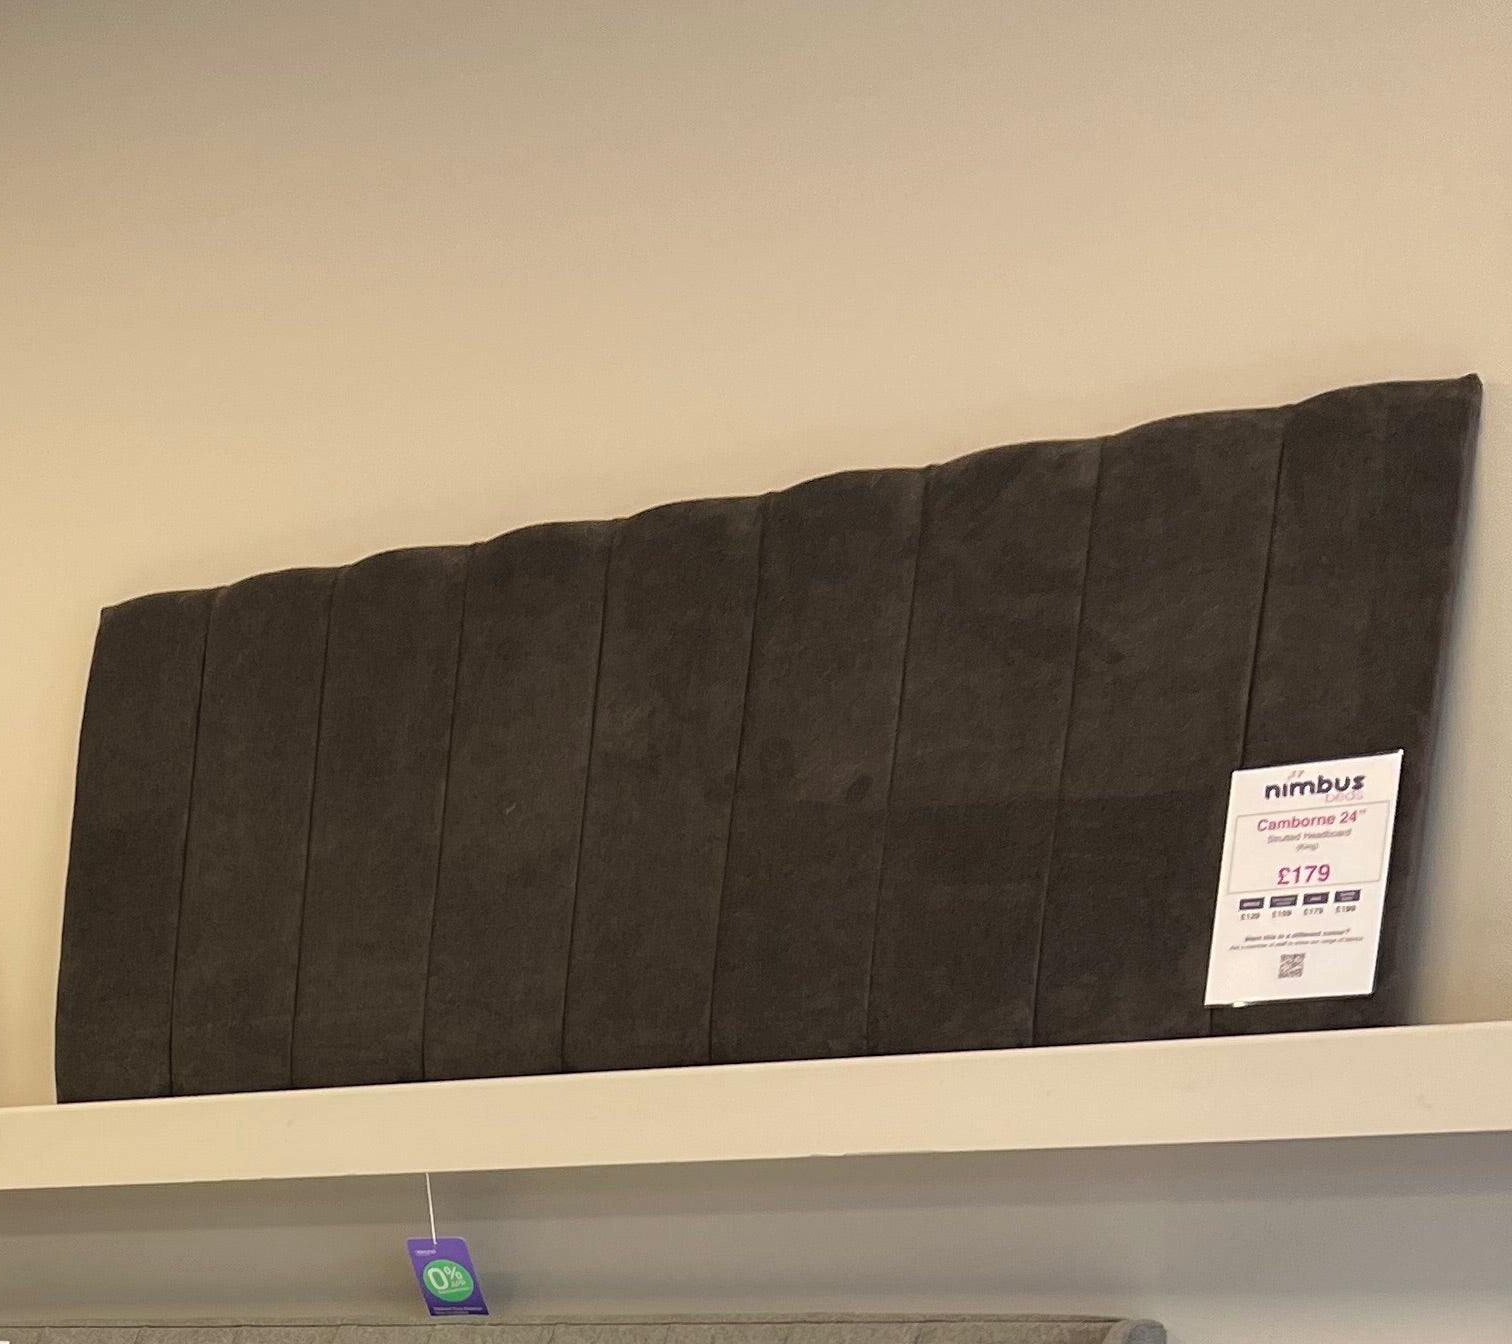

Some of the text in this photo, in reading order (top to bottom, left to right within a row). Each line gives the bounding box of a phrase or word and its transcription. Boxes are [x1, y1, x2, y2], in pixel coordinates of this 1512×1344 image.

[1265, 775, 1365, 799] nimbus
[1257, 814, 1335, 832] Camborne
[1277, 864, 1330, 885] £179
[428, 1266, 463, 1290] 0%
